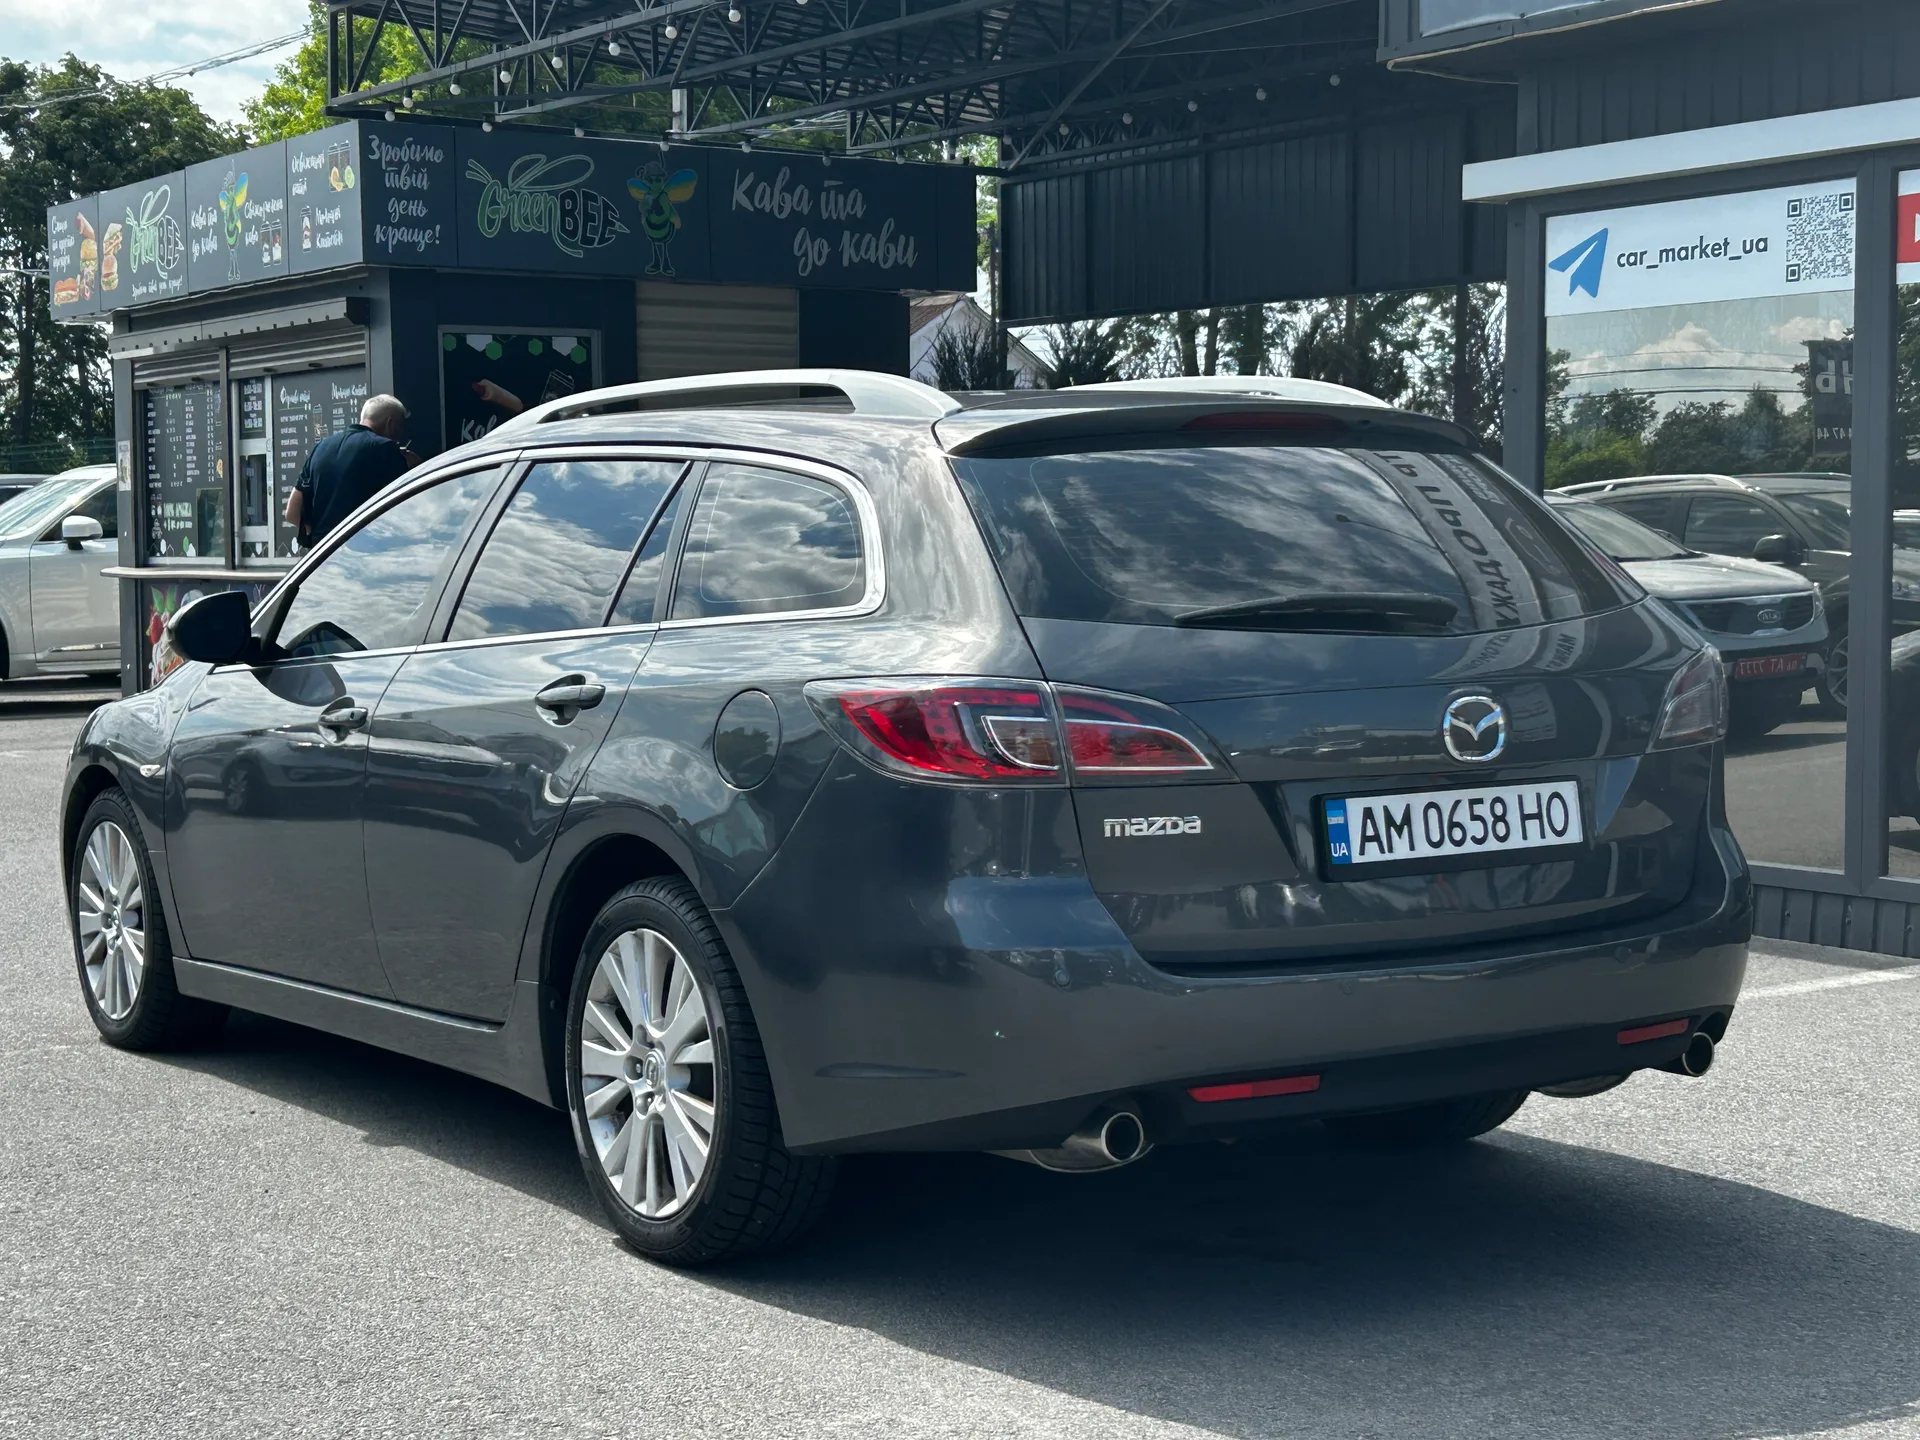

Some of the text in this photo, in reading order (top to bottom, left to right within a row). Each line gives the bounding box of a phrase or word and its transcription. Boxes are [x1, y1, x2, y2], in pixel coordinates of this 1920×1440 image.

[368, 134, 445, 169] Зробимо
[385, 163, 430, 191] твій
[731, 166, 866, 221] Кава та
[388, 197, 429, 223] день
[373, 224, 441, 254] краще!
[793, 217, 919, 277] до кави
[1617, 235, 1769, 269] car_market_ua
[1359, 791, 1570, 856] AM 0658 HO
[1331, 842, 1348, 858] UA
